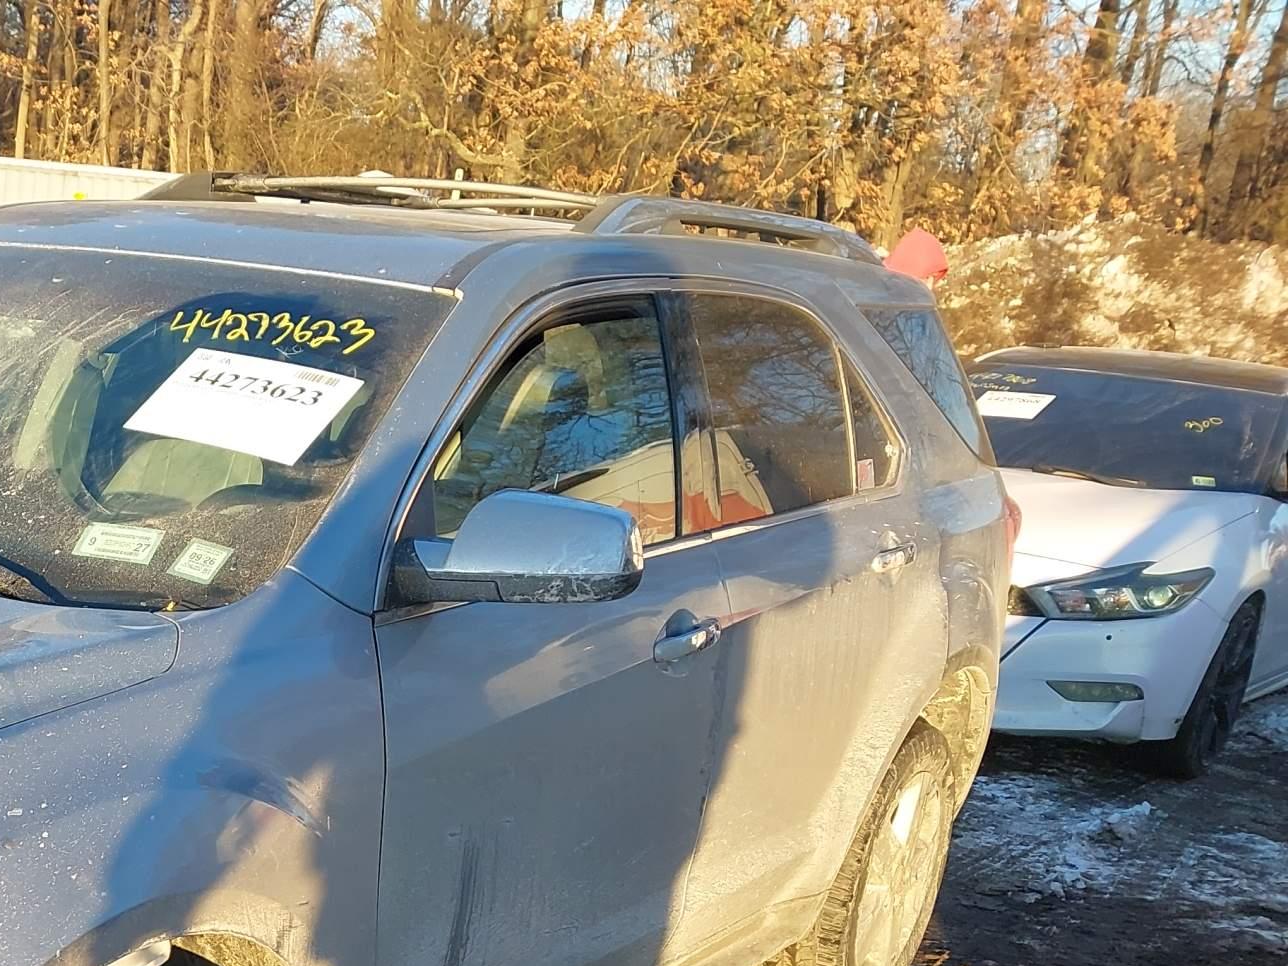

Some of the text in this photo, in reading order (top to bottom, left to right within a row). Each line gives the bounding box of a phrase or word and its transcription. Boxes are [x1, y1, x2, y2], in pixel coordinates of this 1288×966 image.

[170, 309, 376, 354] 44273623
[189, 368, 324, 406] 44273623
[133, 542, 151, 553] 27
